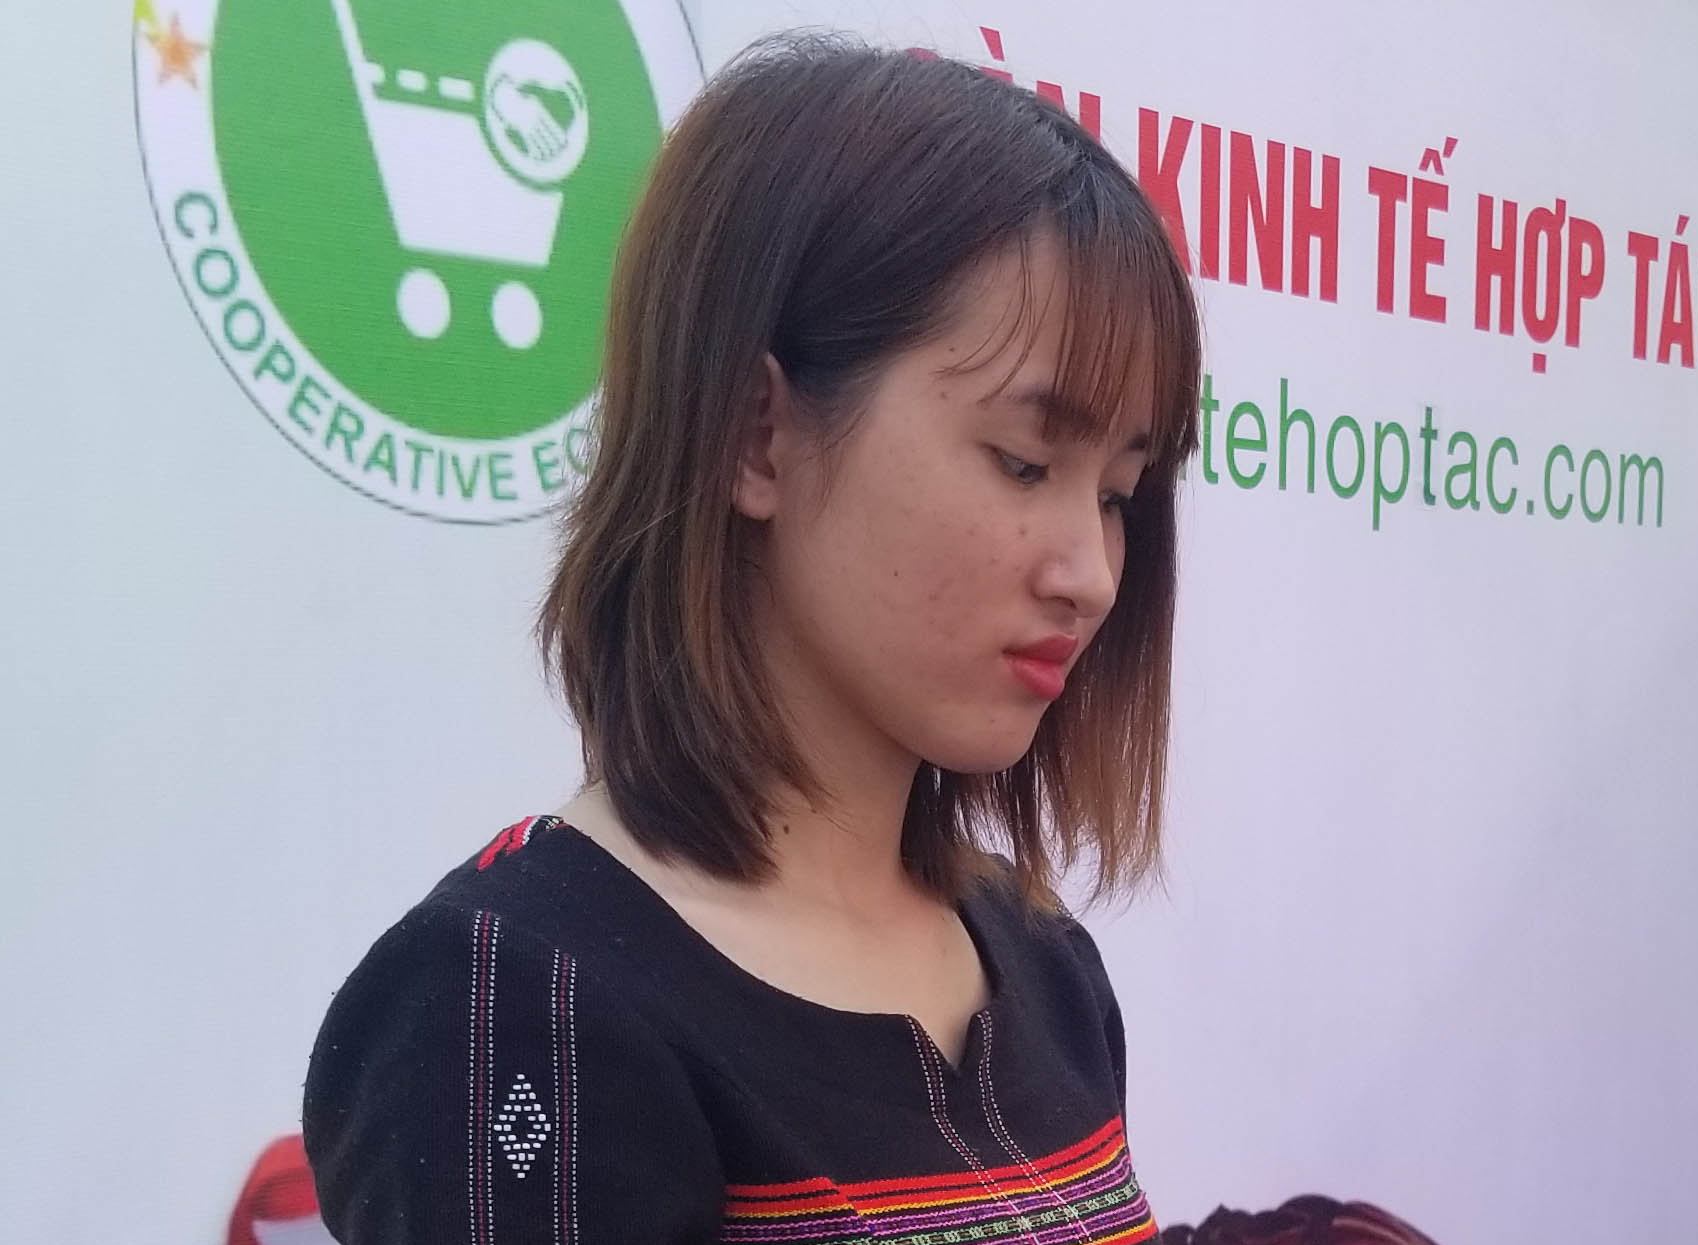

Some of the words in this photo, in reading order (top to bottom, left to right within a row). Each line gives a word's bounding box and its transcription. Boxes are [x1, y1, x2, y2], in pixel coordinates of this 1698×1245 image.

[173, 190, 518, 502] COOPERATIVE
[1138, 107, 1341, 304] KINH
[1368, 137, 1459, 325] TẾ
[1475, 194, 1604, 373] HỢP
[1199, 372, 1664, 532] tehoptac.com
